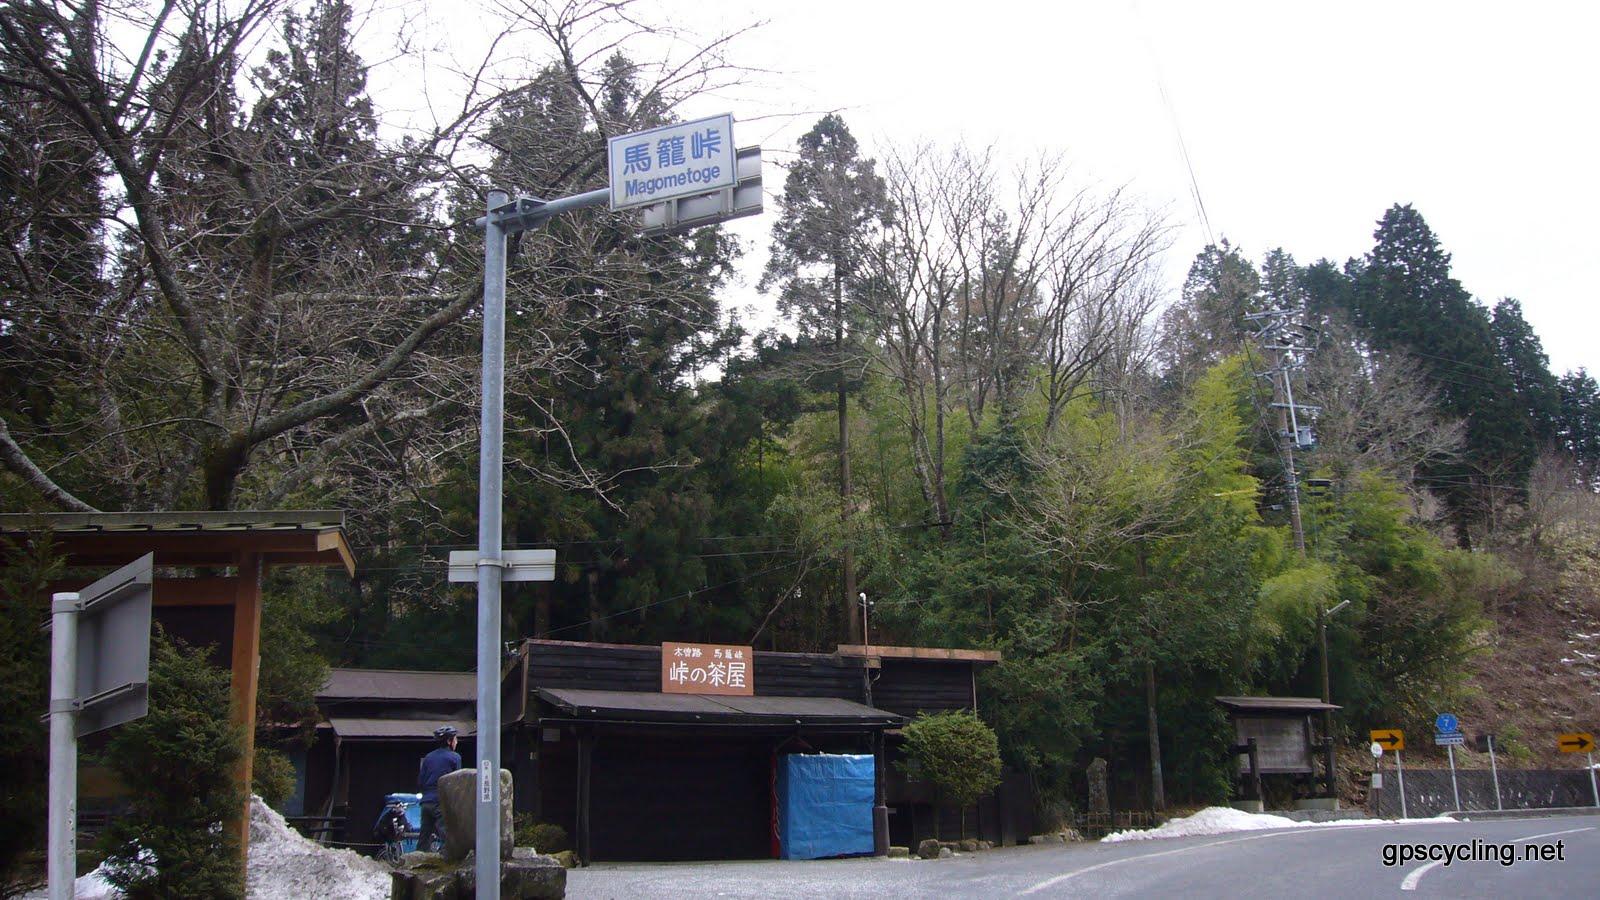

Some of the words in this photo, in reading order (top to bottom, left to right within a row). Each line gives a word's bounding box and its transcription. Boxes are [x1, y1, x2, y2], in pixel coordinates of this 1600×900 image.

[624, 129, 721, 176] 馬籠峠
[624, 165, 721, 198] Magometoge
[670, 660, 746, 688] 峠の茶屋
